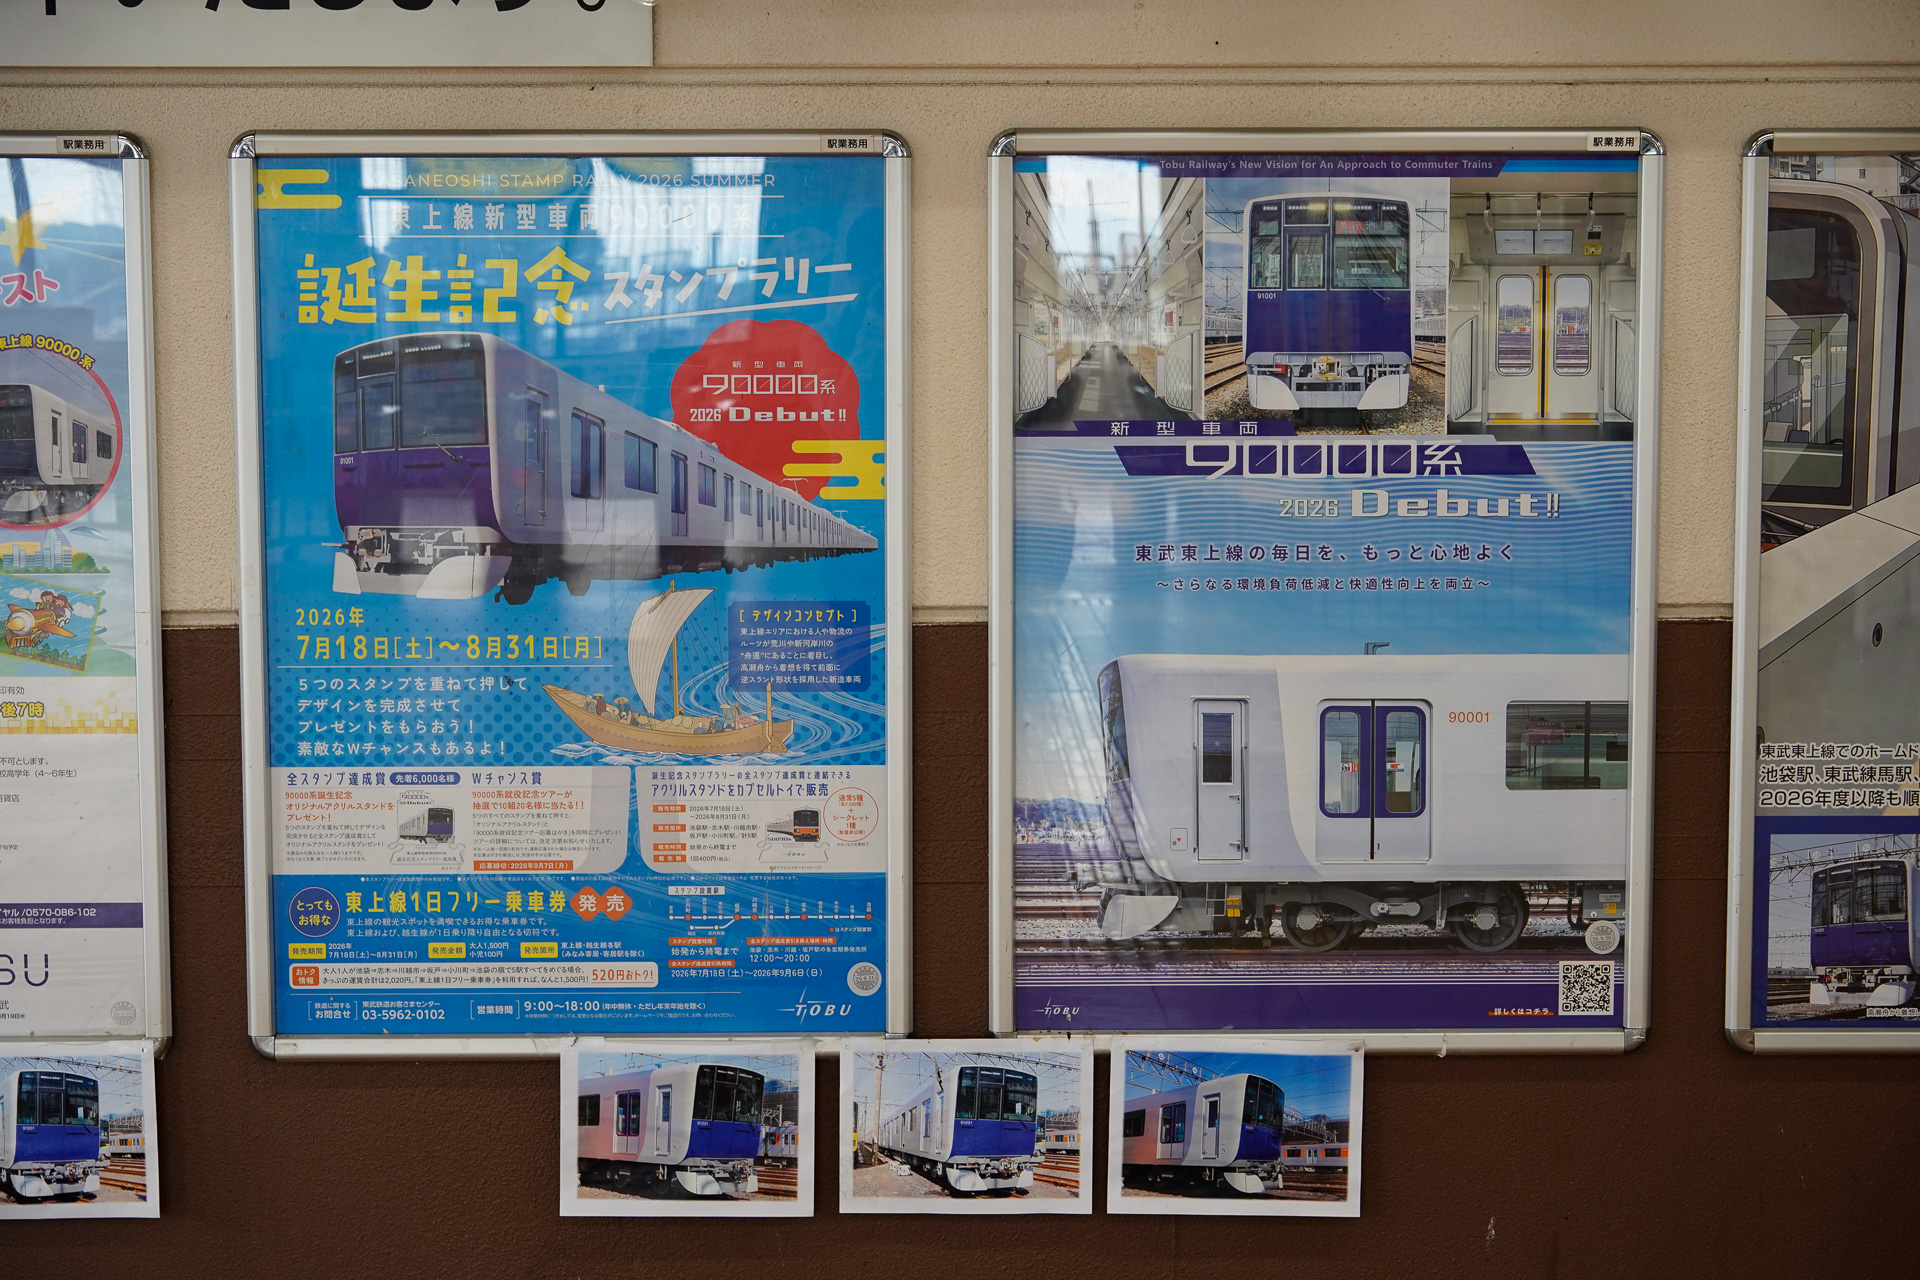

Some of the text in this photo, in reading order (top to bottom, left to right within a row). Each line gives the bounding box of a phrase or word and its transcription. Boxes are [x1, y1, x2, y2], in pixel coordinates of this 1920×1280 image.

[63, 139, 105, 150] 駅業務用
[827, 138, 868, 149] 駅業務用
[1592, 137, 1635, 147] 駅業務用
[1160, 160, 1185, 169] Tobu
[1240, 160, 1262, 169] New
[1266, 160, 1297, 169] Vision
[1301, 160, 1316, 169] for
[1320, 160, 1334, 169] An
[1337, 160, 1387, 171] Approach
[1391, 161, 1401, 169] to
[1405, 160, 1459, 169] Commuter
[1462, 160, 1493, 169] Trains
[500, 174, 565, 188] STAMP
[573, 174, 632, 188] RALLY
[638, 174, 684, 188] 2026
[690, 174, 776, 188] SUMMER
[0, 268, 60, 307] スト
[297, 246, 591, 326] 誕生記念
[603, 256, 853, 311] スタンプラリー
[1257, 292, 1276, 300] 91001
[732, 360, 804, 369] 新型車両
[702, 374, 836, 395] 90000系
[690, 408, 722, 422] 2026
[1110, 421, 1258, 436] 新型車両
[339, 456, 354, 465] 91001
[1185, 439, 1463, 480] 90000系
[1279, 498, 1340, 518] 2026
[296, 607, 365, 627] 2026年
[740, 627, 853, 636] 東上線エリアにおける人や物流の
[740, 639, 834, 648] ルーツが荒川や新河岸川の
[740, 663, 841, 672] 高瀬舟から着想を得て前面に
[299, 675, 528, 692] 5つのスタンプを重ねて押して
[0, 701, 45, 717] 後7時
[297, 698, 462, 714] デザインを完成させて
[1448, 711, 1490, 723] 90001
[297, 719, 475, 735] プレゼントをもらおう！
[297, 741, 506, 757] 素敵なWチャンスもあるよ！
[1761, 744, 1920, 759] 東武東上線でのホームド
[0, 757, 49, 765] 不可とします。
[287, 772, 386, 786] 全スタンプ達成賞
[395, 774, 456, 785] 先着6,000名様
[472, 771, 542, 786] Wチャンス賞
[1760, 766, 1920, 783] 池袋駅、東武練馬駅、
[472, 790, 572, 799] 90000系就役記念ツアーが
[651, 782, 830, 797] アクリルスタンドをカプセルトイで販売
[285, 791, 353, 800] 90000系誕生記念
[1760, 790, 1920, 807] 2026年度以降も順
[286, 802, 395, 811] オリジナルアクリルスタンドを
[286, 813, 331, 822] プレゼント！
[833, 814, 870, 822] シークレット
[296, 900, 334, 911] とっても
[345, 890, 566, 913] 東上線1日フリー乗車券
[578, 893, 625, 912] 発売
[0, 908, 20, 917] ヤル
[298, 914, 332, 926] お得な
[292, 947, 324, 956] 発売期間
[431, 946, 464, 955] 発売金額
[524, 946, 555, 955] 発売箇所
[671, 947, 739, 956] 始発から終電まで
[315, 1010, 351, 1019] お問合せ
[362, 1009, 445, 1020] 03-5962-0102
[477, 1004, 514, 1015] 営業時間
[795, 1004, 852, 1016] TOBU
[1044, 1007, 1080, 1015] TOBU
[1494, 1007, 1549, 1015] 詳しくはコチラ
